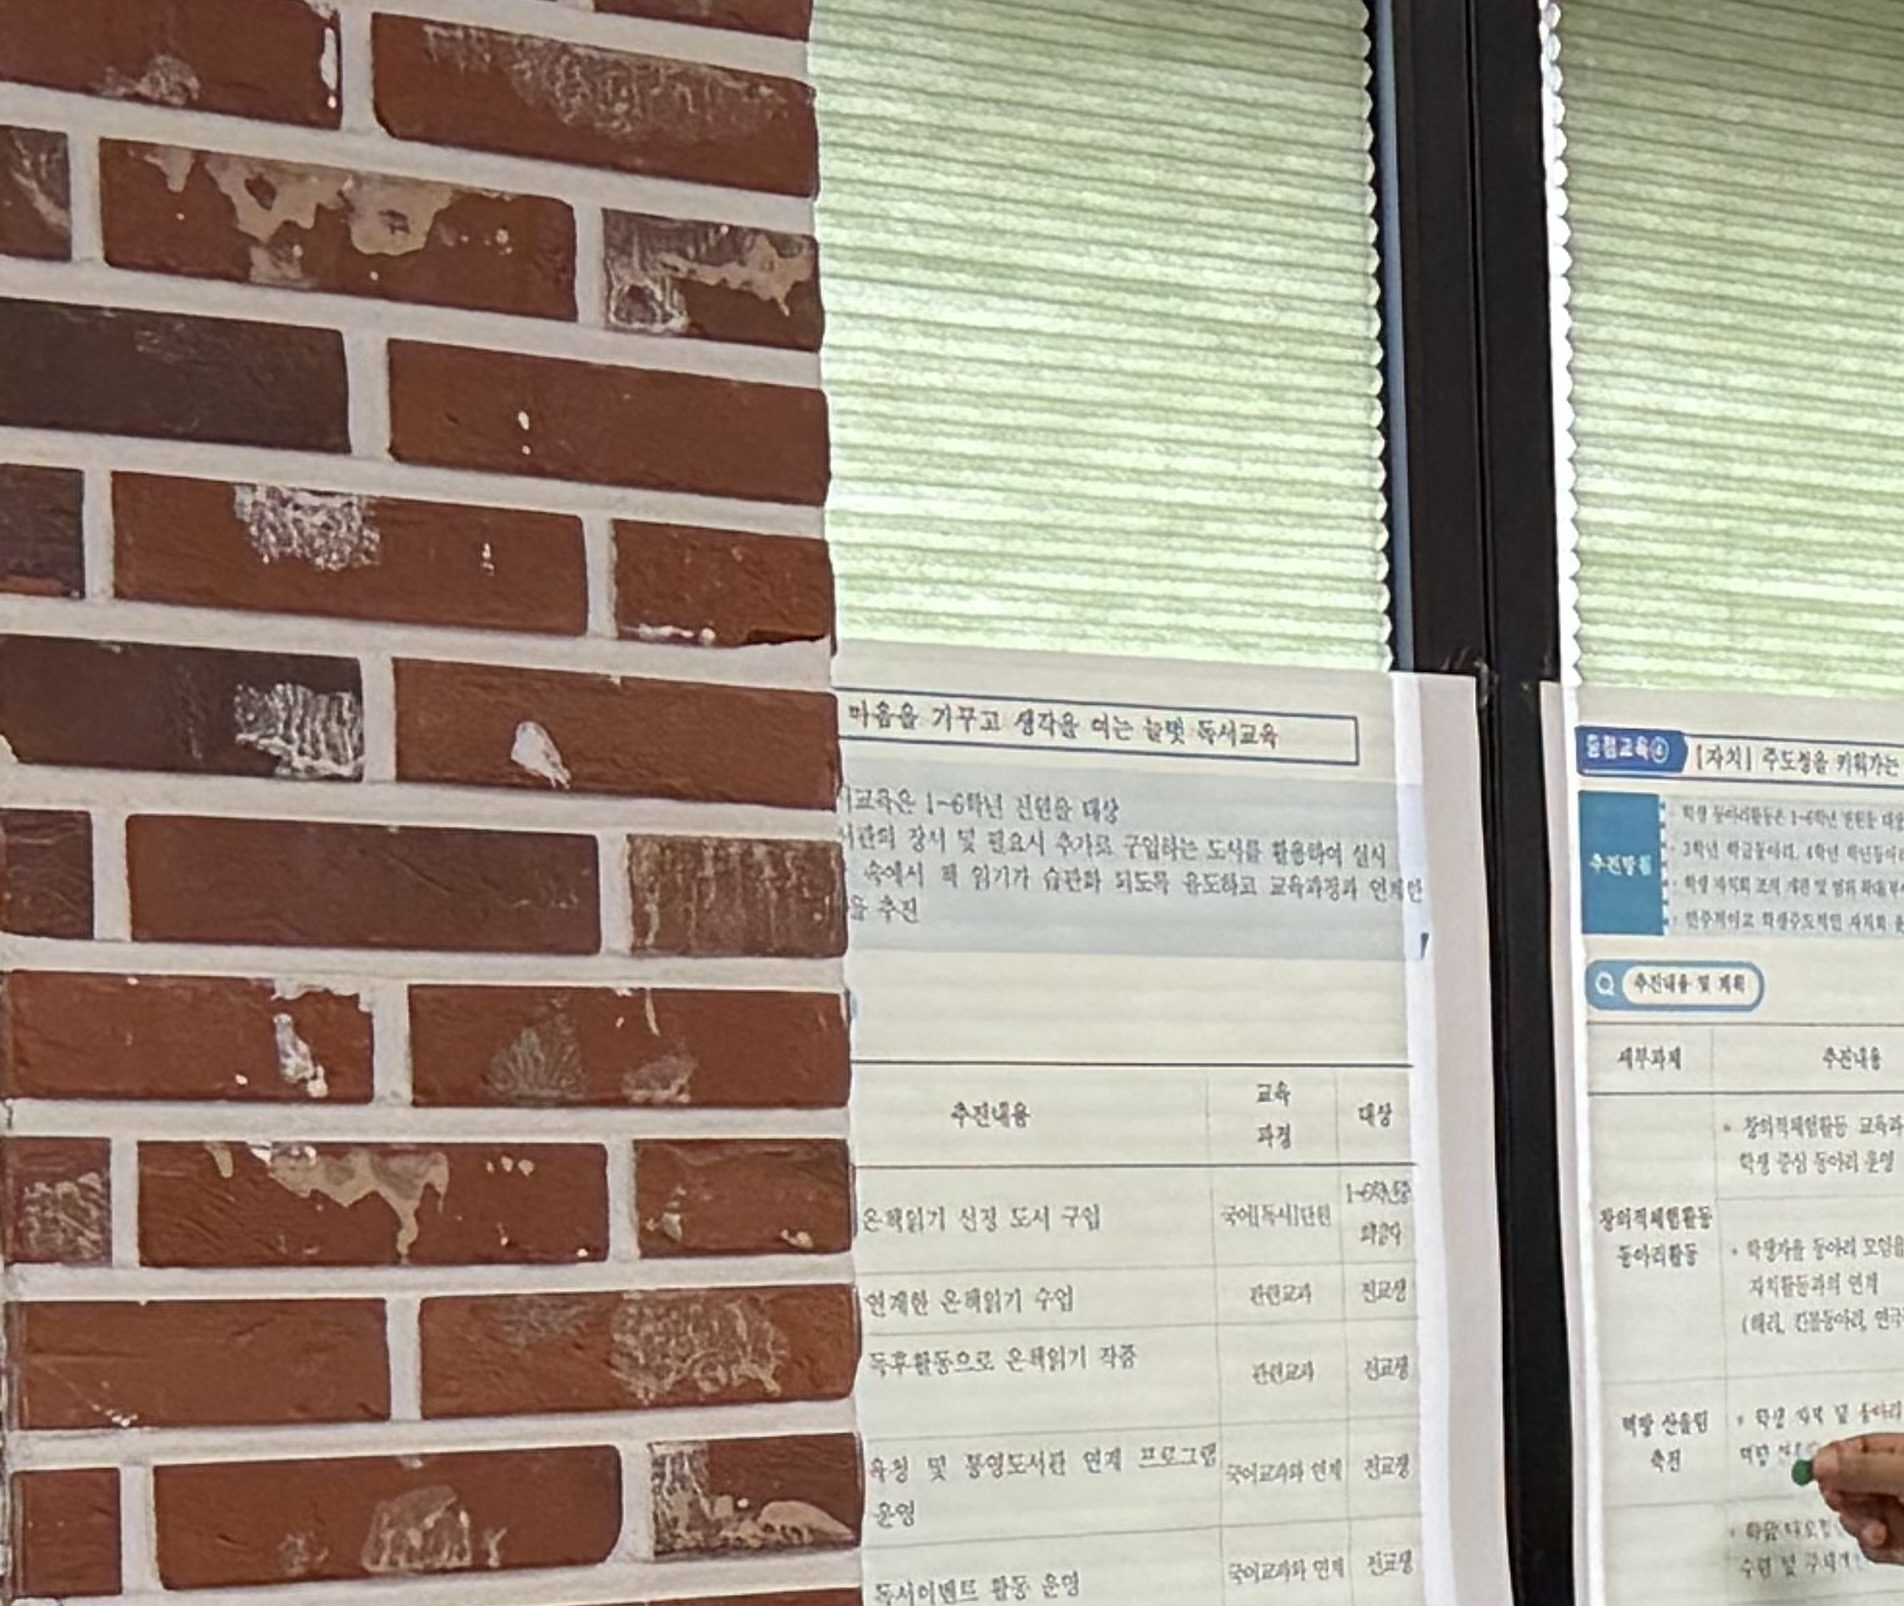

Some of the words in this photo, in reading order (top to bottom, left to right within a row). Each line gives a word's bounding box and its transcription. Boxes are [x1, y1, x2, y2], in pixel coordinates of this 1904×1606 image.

[848, 699, 919, 730] 마음을
[1014, 708, 1080, 739] 생각을
[1091, 712, 1134, 741] 여는
[1197, 720, 1278, 749] 독서교육
[957, 827, 976, 854] 및
[1823, 1046, 1881, 1071] 추진내용
[1257, 1080, 1291, 1107] 교육
[951, 1101, 1030, 1128] 추진내용
[1358, 1102, 1392, 1127] 대상
[1258, 1123, 1291, 1149] 과정
[1010, 1205, 1050, 1231] 도서
[1061, 1204, 1100, 1231] 구입
[1035, 1285, 1073, 1312] 수업
[928, 1454, 946, 1482] 및
[873, 1500, 914, 1529] 운영
[991, 1575, 1031, 1601] 활동
[1042, 1570, 1079, 1599] 운영
